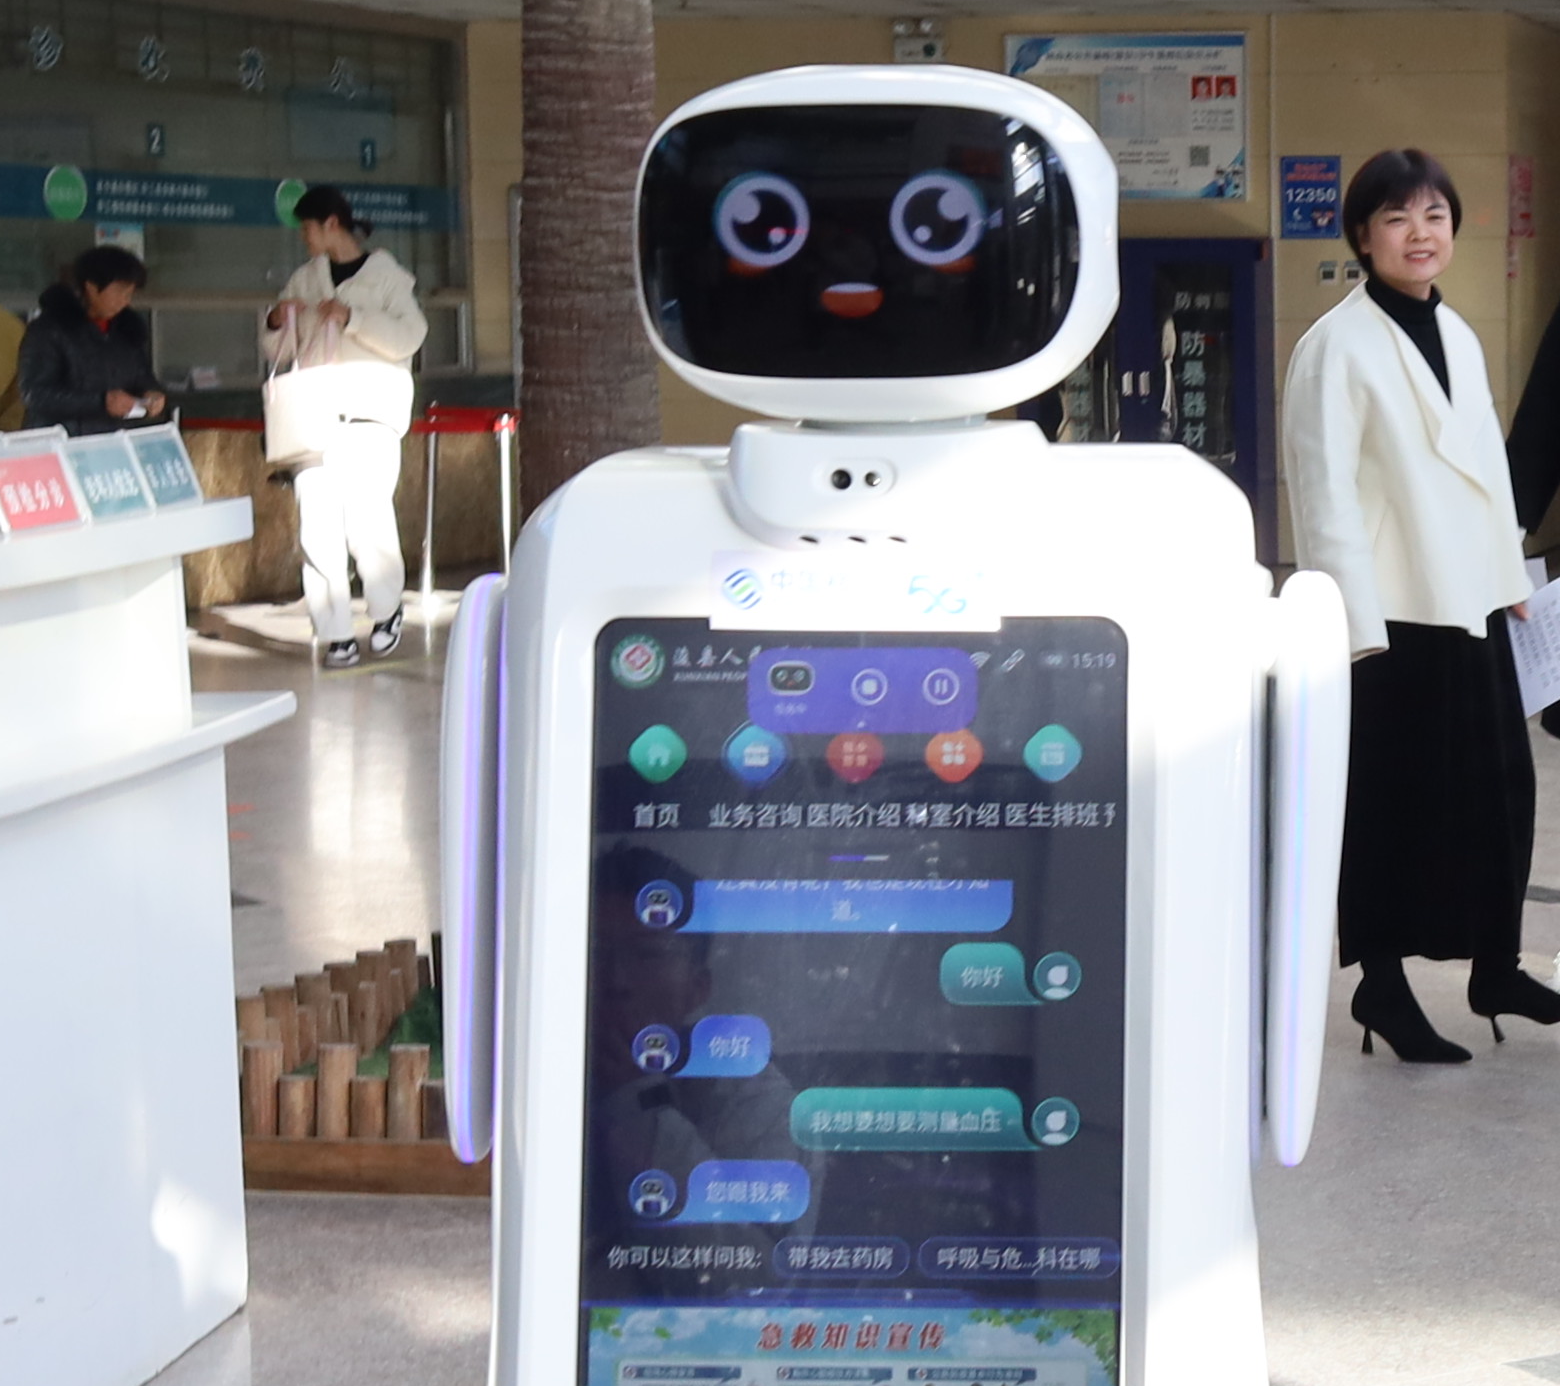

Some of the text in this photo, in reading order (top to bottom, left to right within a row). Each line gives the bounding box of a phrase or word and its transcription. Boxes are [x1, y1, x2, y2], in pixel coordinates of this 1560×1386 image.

[150, 127, 161, 154] 2
[363, 144, 372, 166] 1
[1285, 187, 1336, 204] 12350
[1180, 330, 1208, 448] 防暴器材
[1072, 652, 1116, 670] 15:19
[634, 803, 681, 829] 首页
[709, 803, 802, 829] 业务咨询
[807, 803, 900, 829] 医院介绍
[906, 803, 1000, 829] 科室介绍
[960, 964, 1004, 990] 你好
[708, 1034, 752, 1059] 你好
[809, 1109, 1002, 1135] 我想要想要测量血压
[705, 1179, 791, 1204] 您跟我来
[787, 1245, 893, 1270] 带我去药房
[755, 1320, 947, 1353] 急救知识宣传
